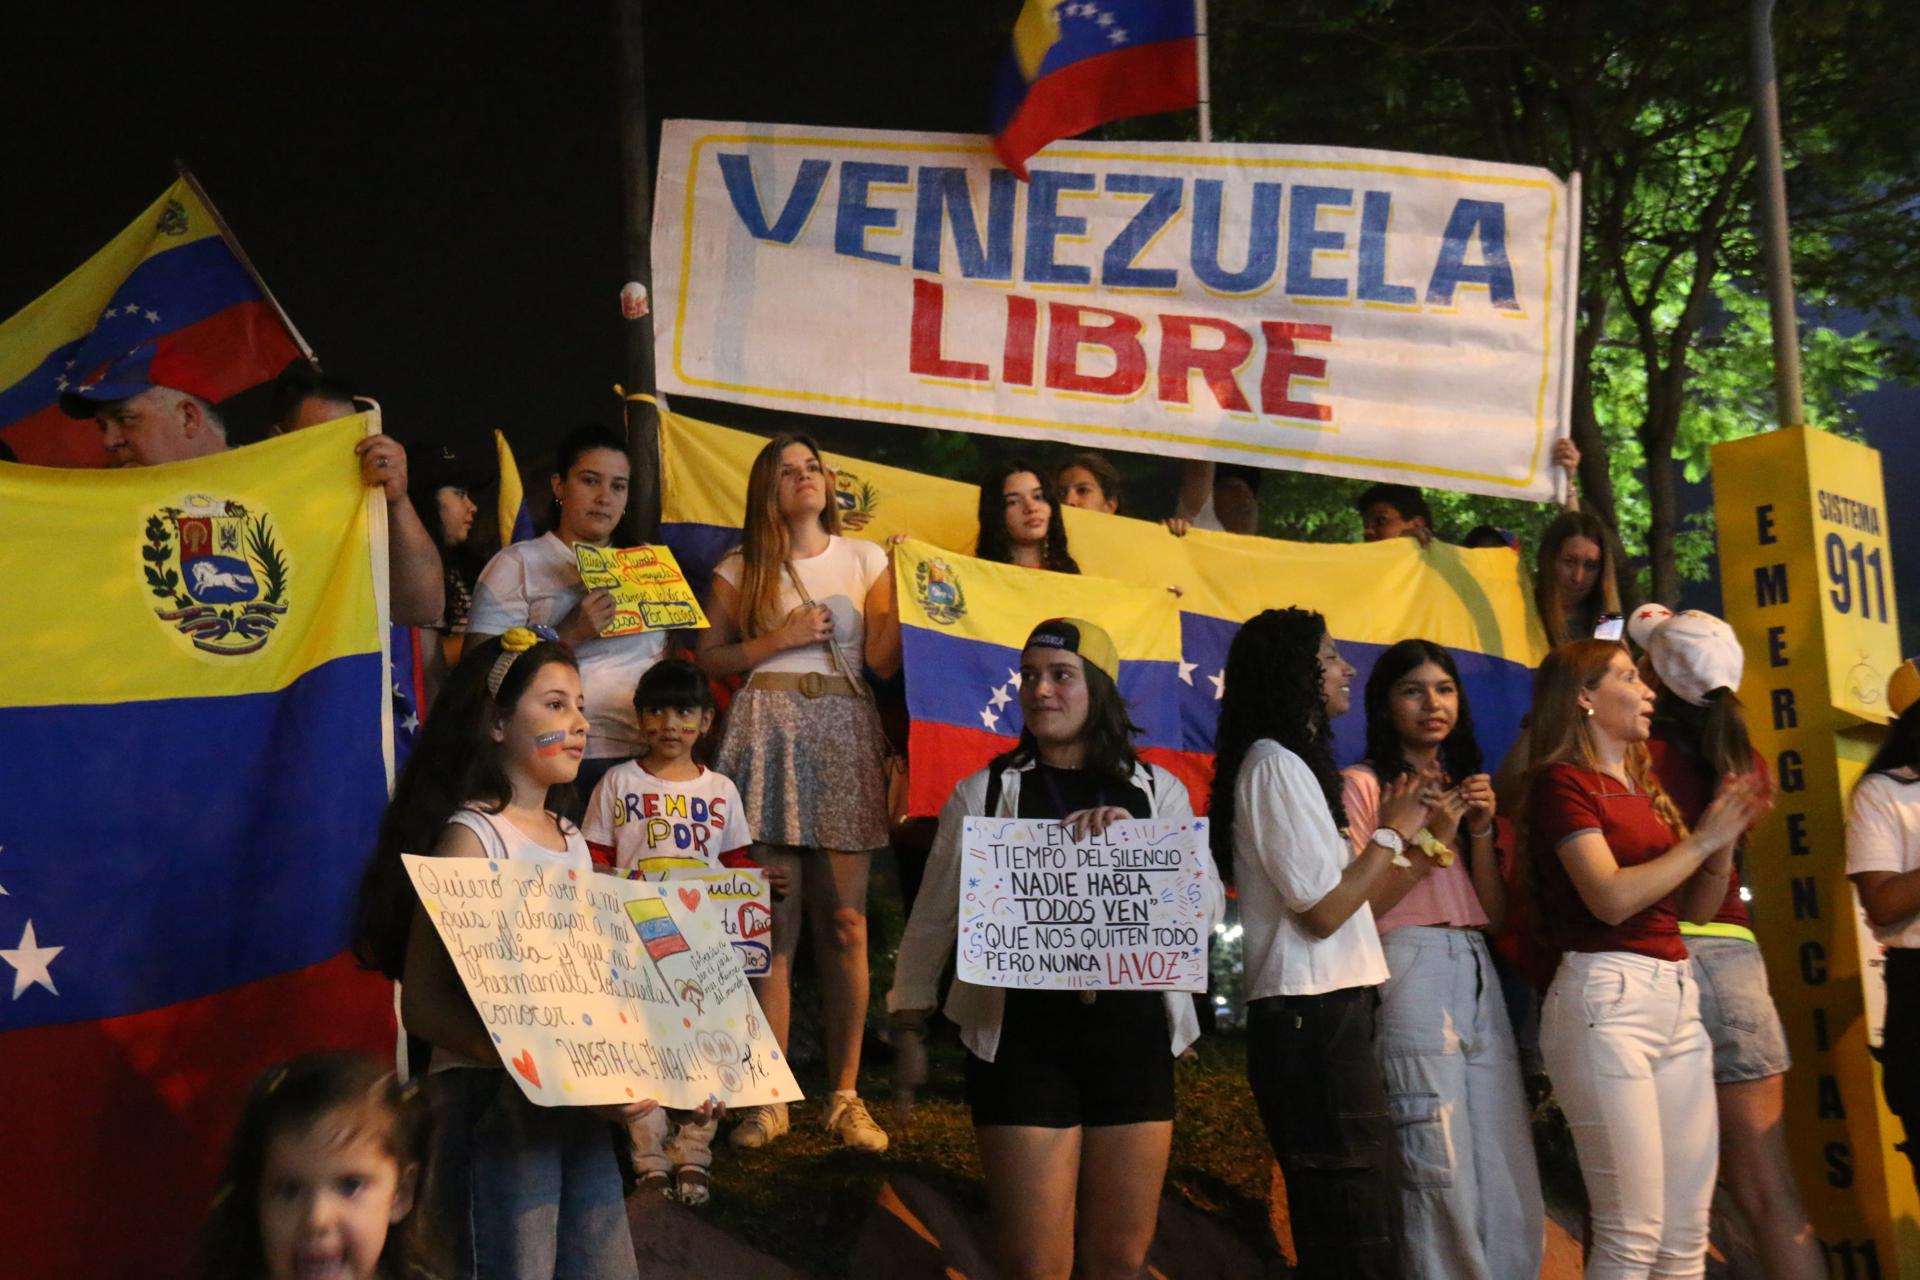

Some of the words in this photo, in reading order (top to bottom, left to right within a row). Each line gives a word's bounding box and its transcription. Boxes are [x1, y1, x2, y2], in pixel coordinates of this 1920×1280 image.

[717, 152, 1523, 315] VENEZUELA
[909, 278, 1335, 424] LIBRE
[1817, 488, 1882, 537] SISTEMA
[1825, 532, 1889, 624] 911
[614, 792, 727, 830] OREMOS
[647, 818, 711, 858] POR
[988, 844, 1066, 869] TIEMPO
[1077, 847, 1110, 868] DEL
[1111, 848, 1182, 870] SILENCIO
[1089, 827, 1116, 847] EL
[1754, 503, 1855, 1189] EMERGENCIAS
[418, 863, 503, 904] Quiero
[512, 863, 581, 902] volver
[601, 890, 622, 914] mi
[1011, 871, 1078, 897] NADIE
[1088, 872, 1152, 896] HABLA
[515, 899, 590, 948] abrazar
[610, 921, 633, 944] mi
[721, 907, 739, 935] te
[1015, 898, 1095, 922] TODOS
[1035, 927, 1076, 949] NOS
[1081, 926, 1148, 949] QUITEN
[1153, 927, 1198, 946] TODO
[984, 951, 1035, 972] PERO
[1039, 953, 1101, 972] NUNCA
[556, 1038, 625, 1078] HASTA
[623, 1041, 649, 1077] EL
